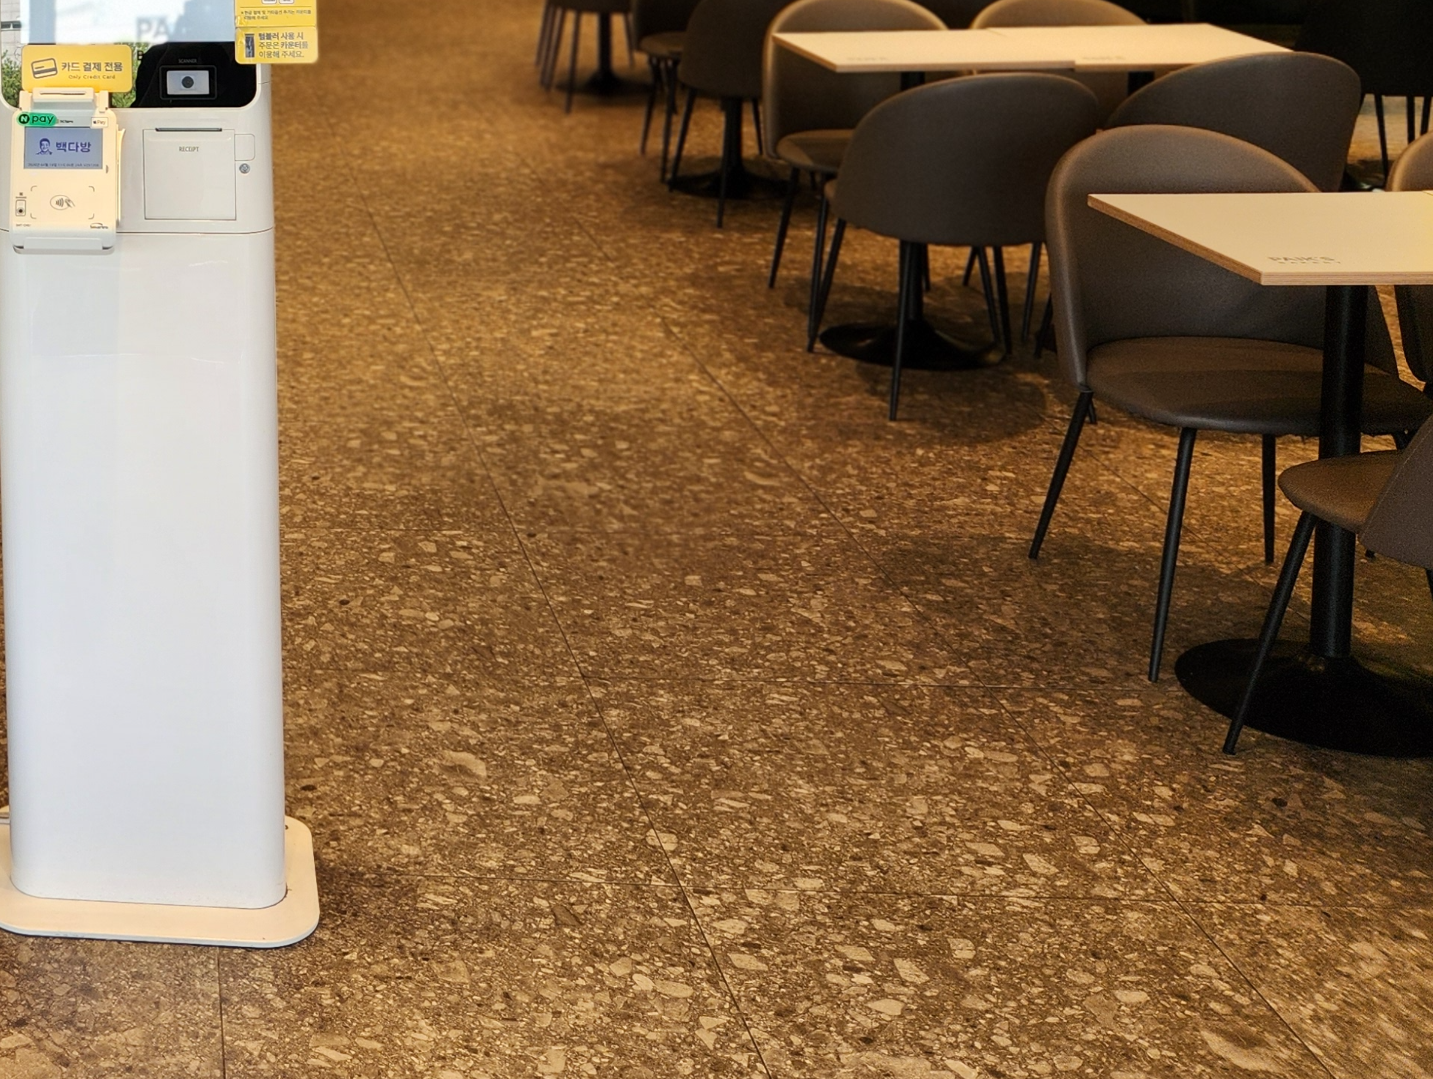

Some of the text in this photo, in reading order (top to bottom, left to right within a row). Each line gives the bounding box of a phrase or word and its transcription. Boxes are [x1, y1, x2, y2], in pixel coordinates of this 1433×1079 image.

[61, 61, 123, 72] 카드 결제 전용
